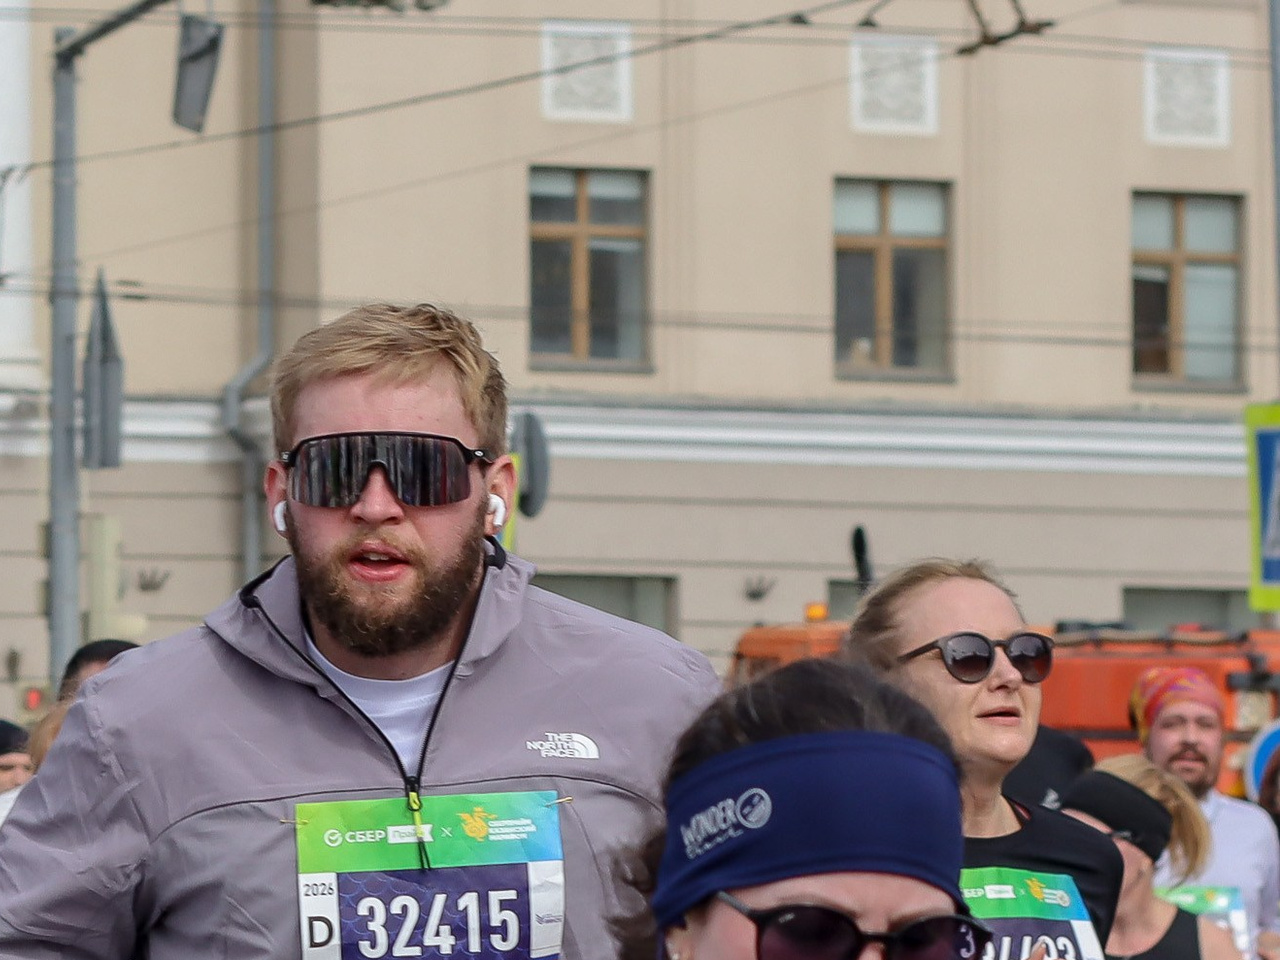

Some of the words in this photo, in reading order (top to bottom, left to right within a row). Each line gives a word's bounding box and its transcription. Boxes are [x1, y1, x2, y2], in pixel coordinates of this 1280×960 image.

[544, 732, 573, 742] THE
[525, 740, 575, 751] NORTH
[540, 749, 575, 758] FACE
[345, 829, 386, 843] СБЕР
[303, 882, 335, 897] 2026
[356, 889, 520, 959] 32415
[307, 916, 334, 949] D
